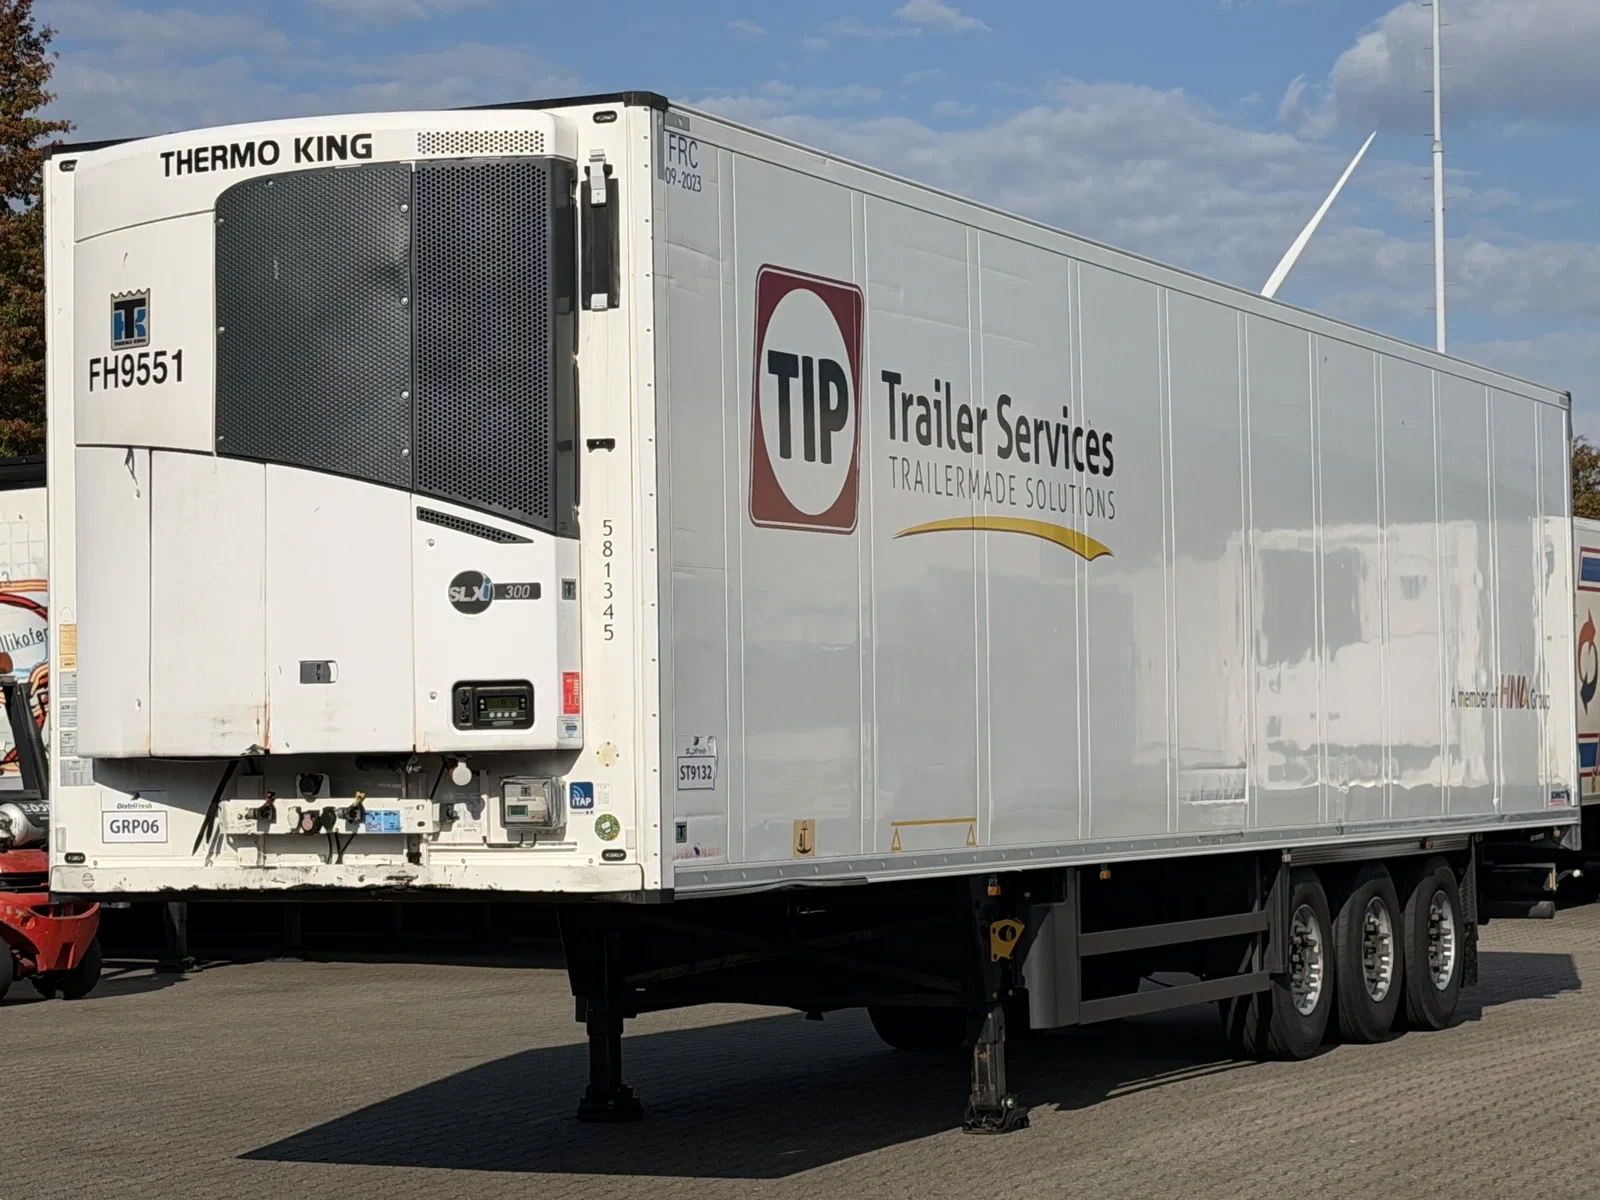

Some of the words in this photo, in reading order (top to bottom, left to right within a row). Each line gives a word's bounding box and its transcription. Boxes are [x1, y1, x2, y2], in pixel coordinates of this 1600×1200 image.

[160, 140, 280, 178] THERMO
[293, 132, 373, 163] KING
[668, 133, 699, 169] FRC
[665, 166, 702, 193] 09-2023
[89, 348, 183, 393] FH9551
[767, 349, 849, 465] TIP
[881, 370, 988, 455] Trailer
[996, 393, 1115, 478] Services
[888, 455, 1018, 507] TRAILERMADE
[1025, 476, 1116, 521] SOLUTIONS
[504, 584, 531, 600] 300
[602, 518, 615, 641] 581345
[1450, 684, 1457, 709] A
[1458, 685, 1489, 709] member
[1490, 685, 1499, 709] of
[680, 764, 713, 781] ST9132
[117, 802, 153, 810] DistriFresh
[572, 795, 592, 807] iTAP
[109, 818, 160, 835] GRP06
